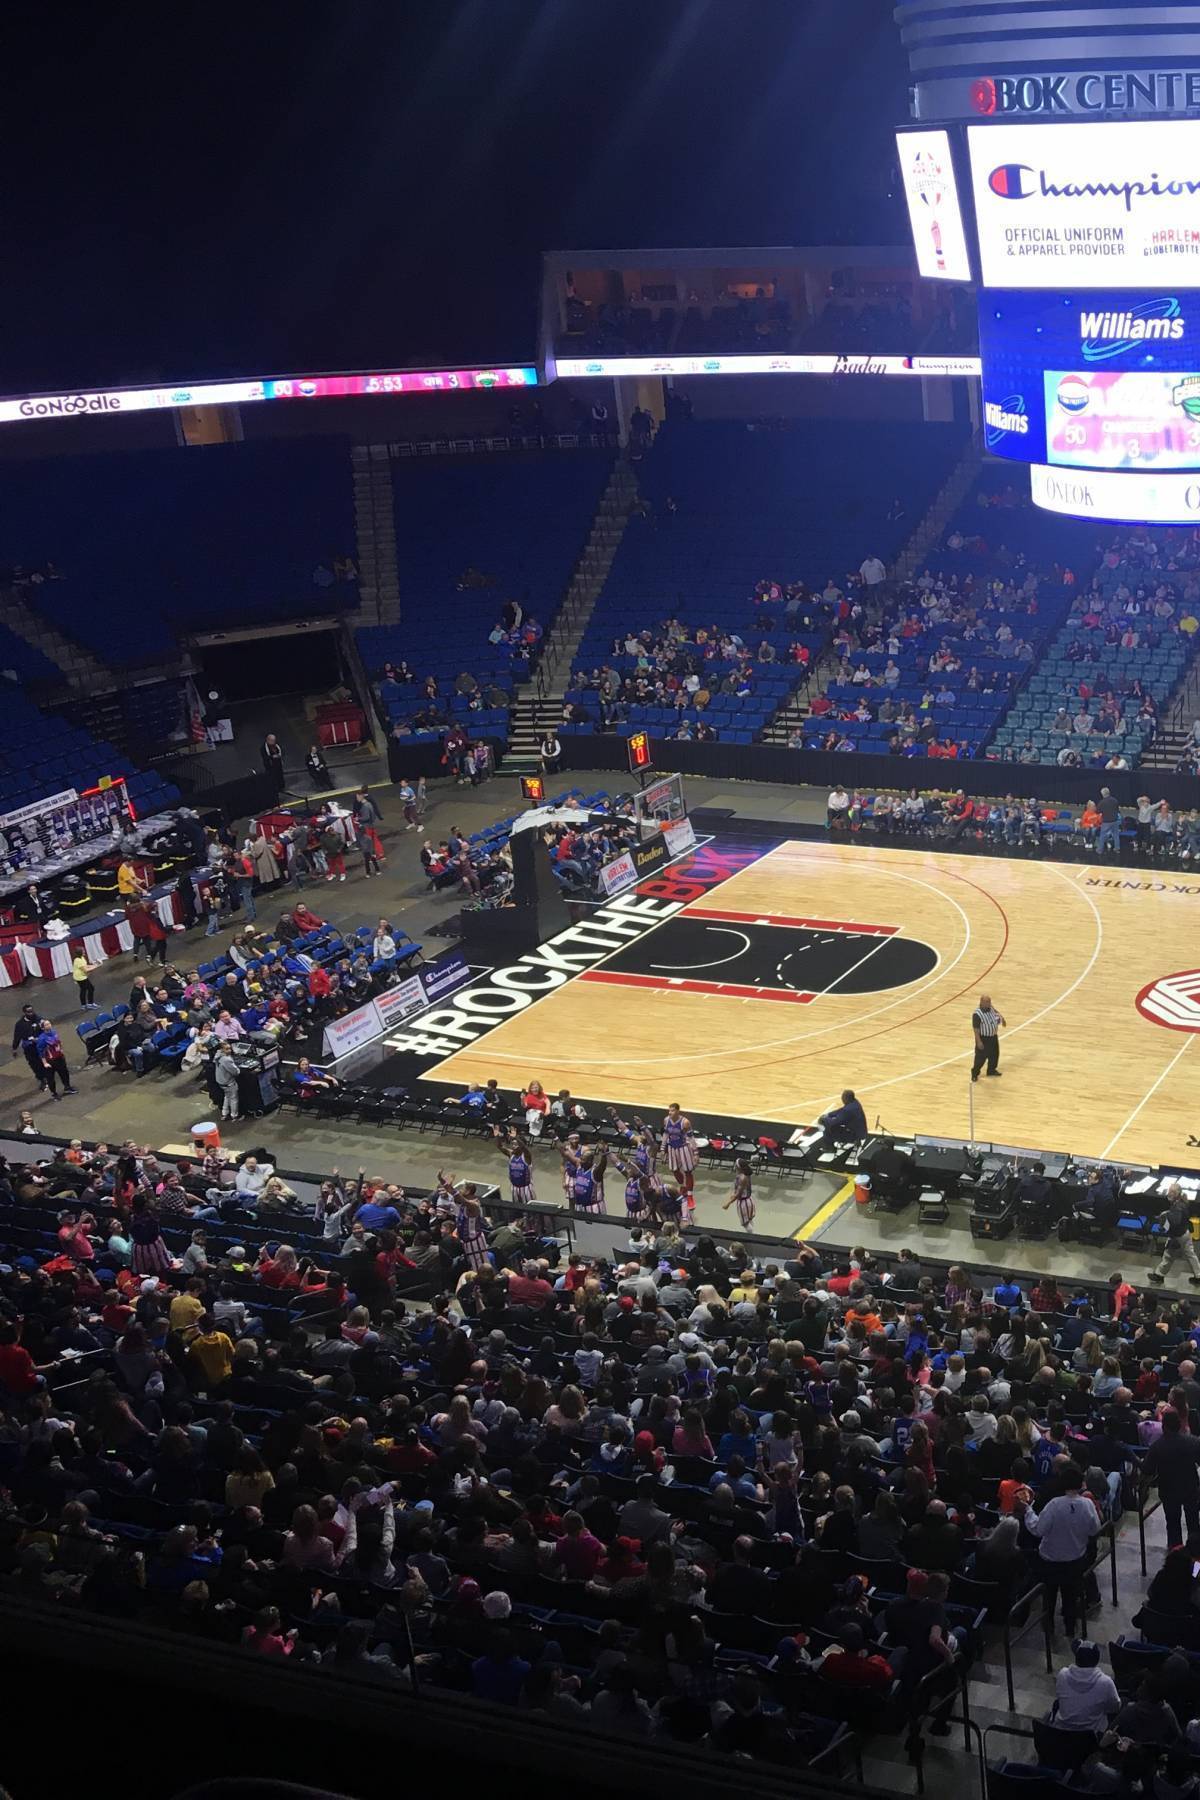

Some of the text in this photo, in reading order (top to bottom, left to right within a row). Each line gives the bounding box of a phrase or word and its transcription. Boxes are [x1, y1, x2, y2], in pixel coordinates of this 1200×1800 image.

[998, 75, 1071, 113] BOK
[1004, 227, 1124, 242] OFFICIAL UNIFORM
[1151, 229, 1200, 244] HARLEM
[1006, 243, 1125, 256] & APPAREL PROVIDER
[1080, 312, 1184, 339] Williams
[832, 356, 888, 375] Baden
[902, 355, 975, 375] Champion
[448, 374, 459, 388] 3
[19, 394, 121, 416] GoNoodle
[985, 402, 1029, 434] Williams
[1064, 426, 1088, 446] 50
[1127, 438, 1141, 459] 3
[1046, 476, 1095, 507] ONEOK
[636, 747, 645, 764] 0
[637, 847, 664, 866] Baden
[1085, 876, 1167, 892] CENTER
[425, 960, 461, 983] Champion
